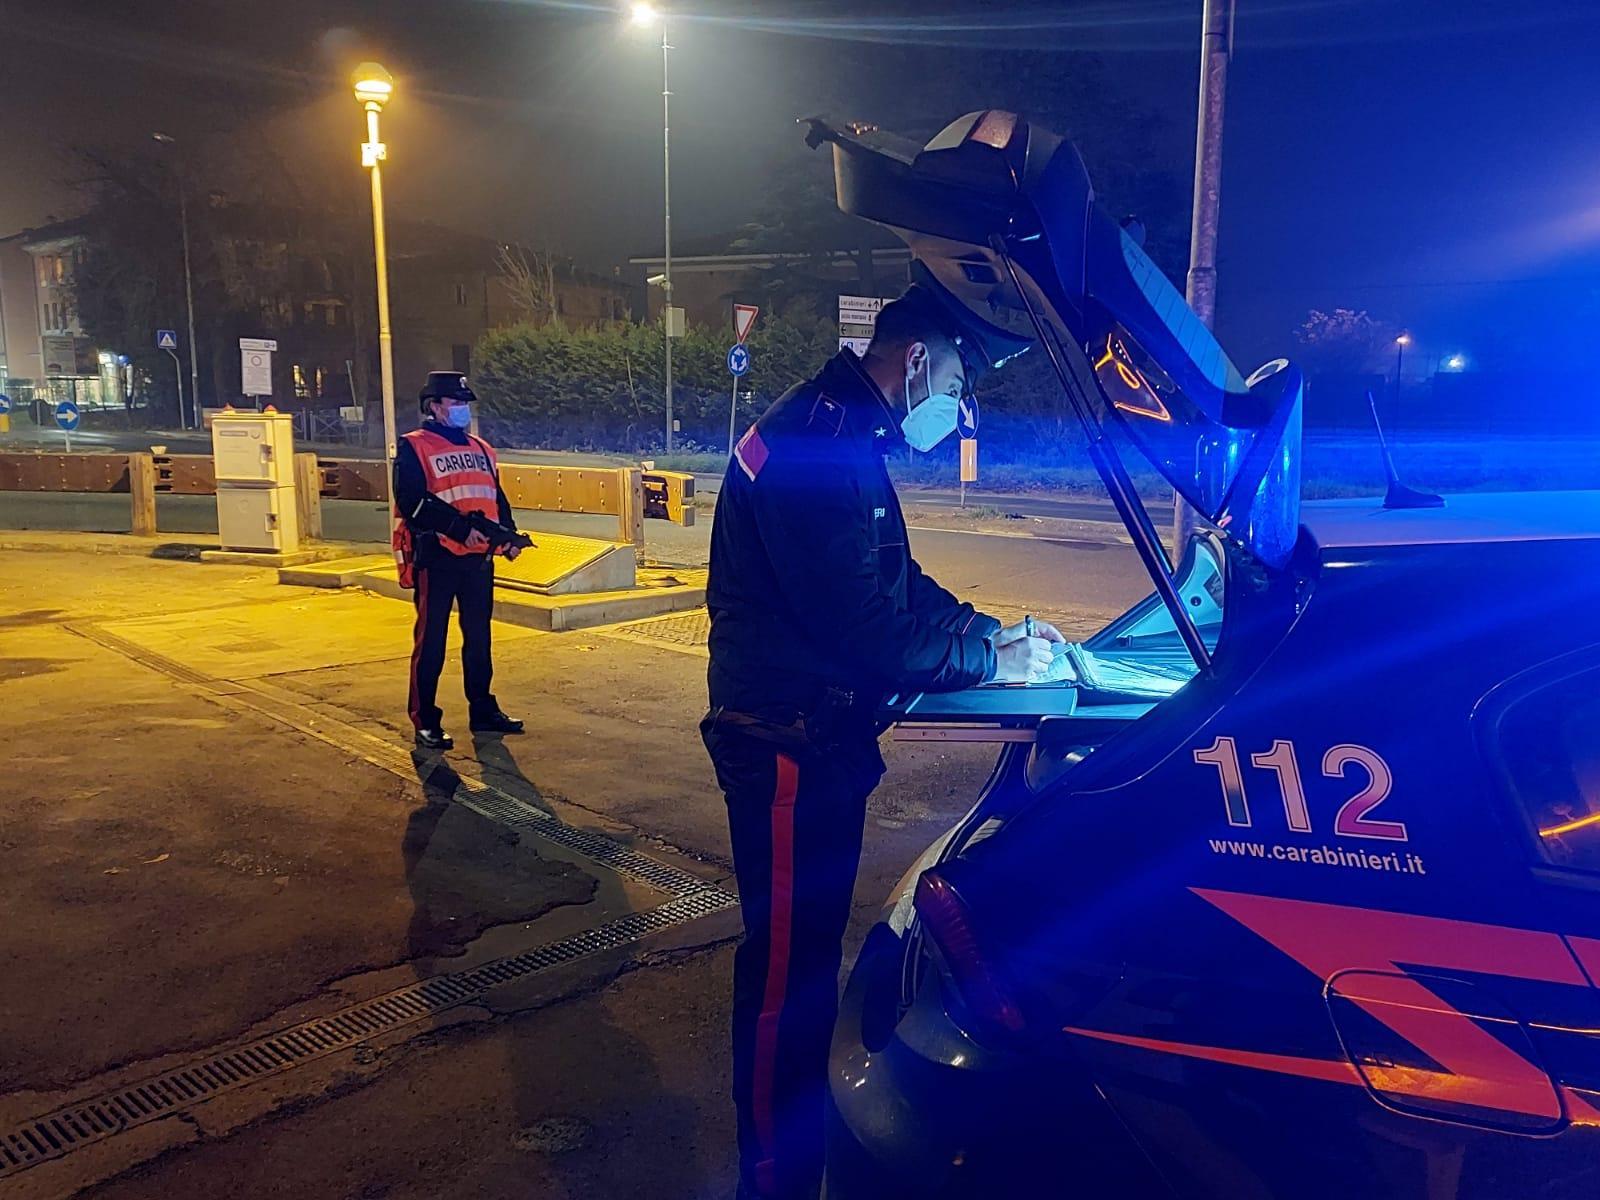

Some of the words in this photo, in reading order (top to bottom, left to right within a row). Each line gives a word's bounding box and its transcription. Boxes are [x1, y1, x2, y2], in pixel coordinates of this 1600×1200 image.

[435, 453, 490, 473] CARABINIE
[1193, 735, 1409, 842] 112
[1208, 839, 1426, 875] www.carabinieri.it
